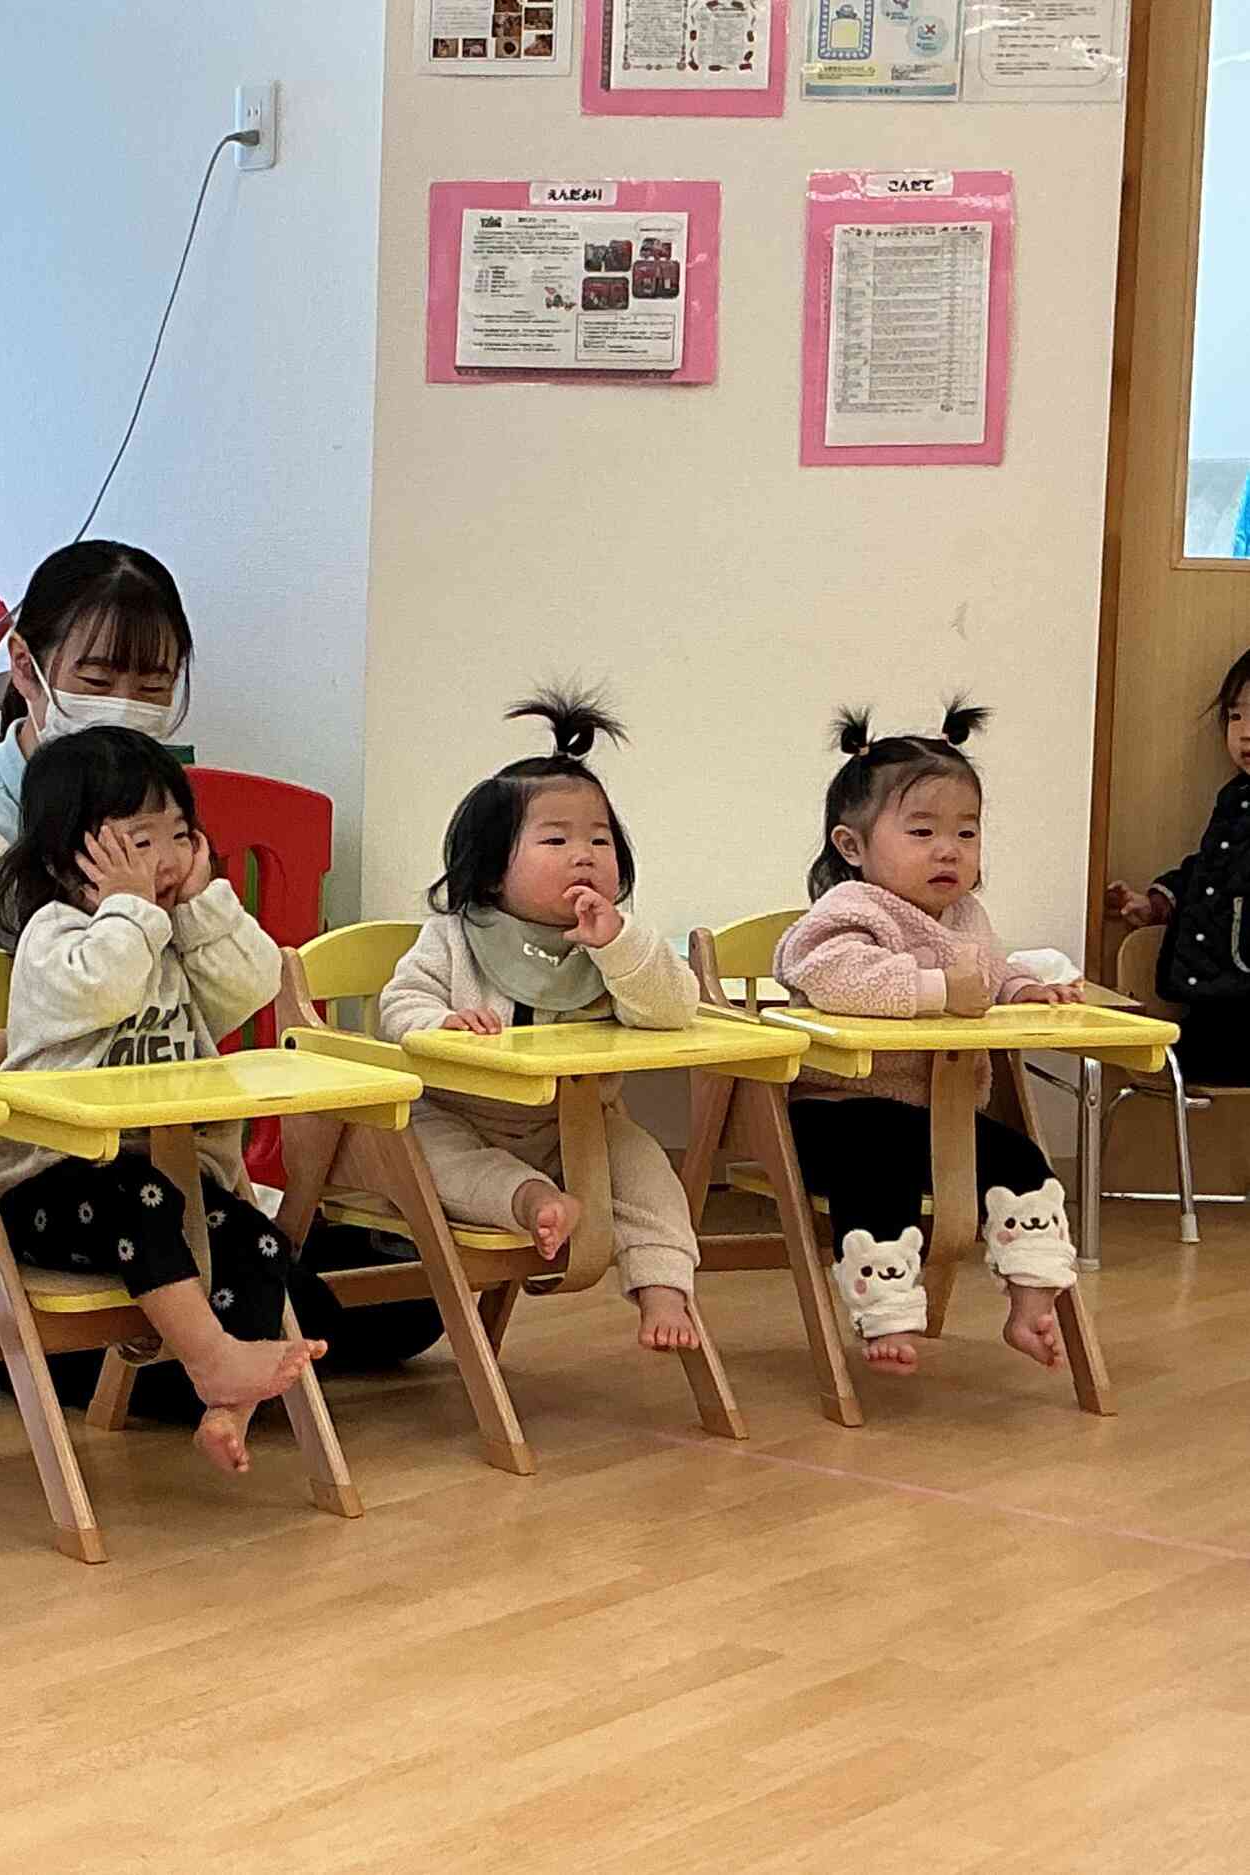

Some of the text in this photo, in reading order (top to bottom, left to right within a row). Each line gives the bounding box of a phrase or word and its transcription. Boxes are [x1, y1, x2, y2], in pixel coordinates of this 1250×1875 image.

[887, 179, 935, 192] こんだて
[548, 187, 602, 201] えんだより
